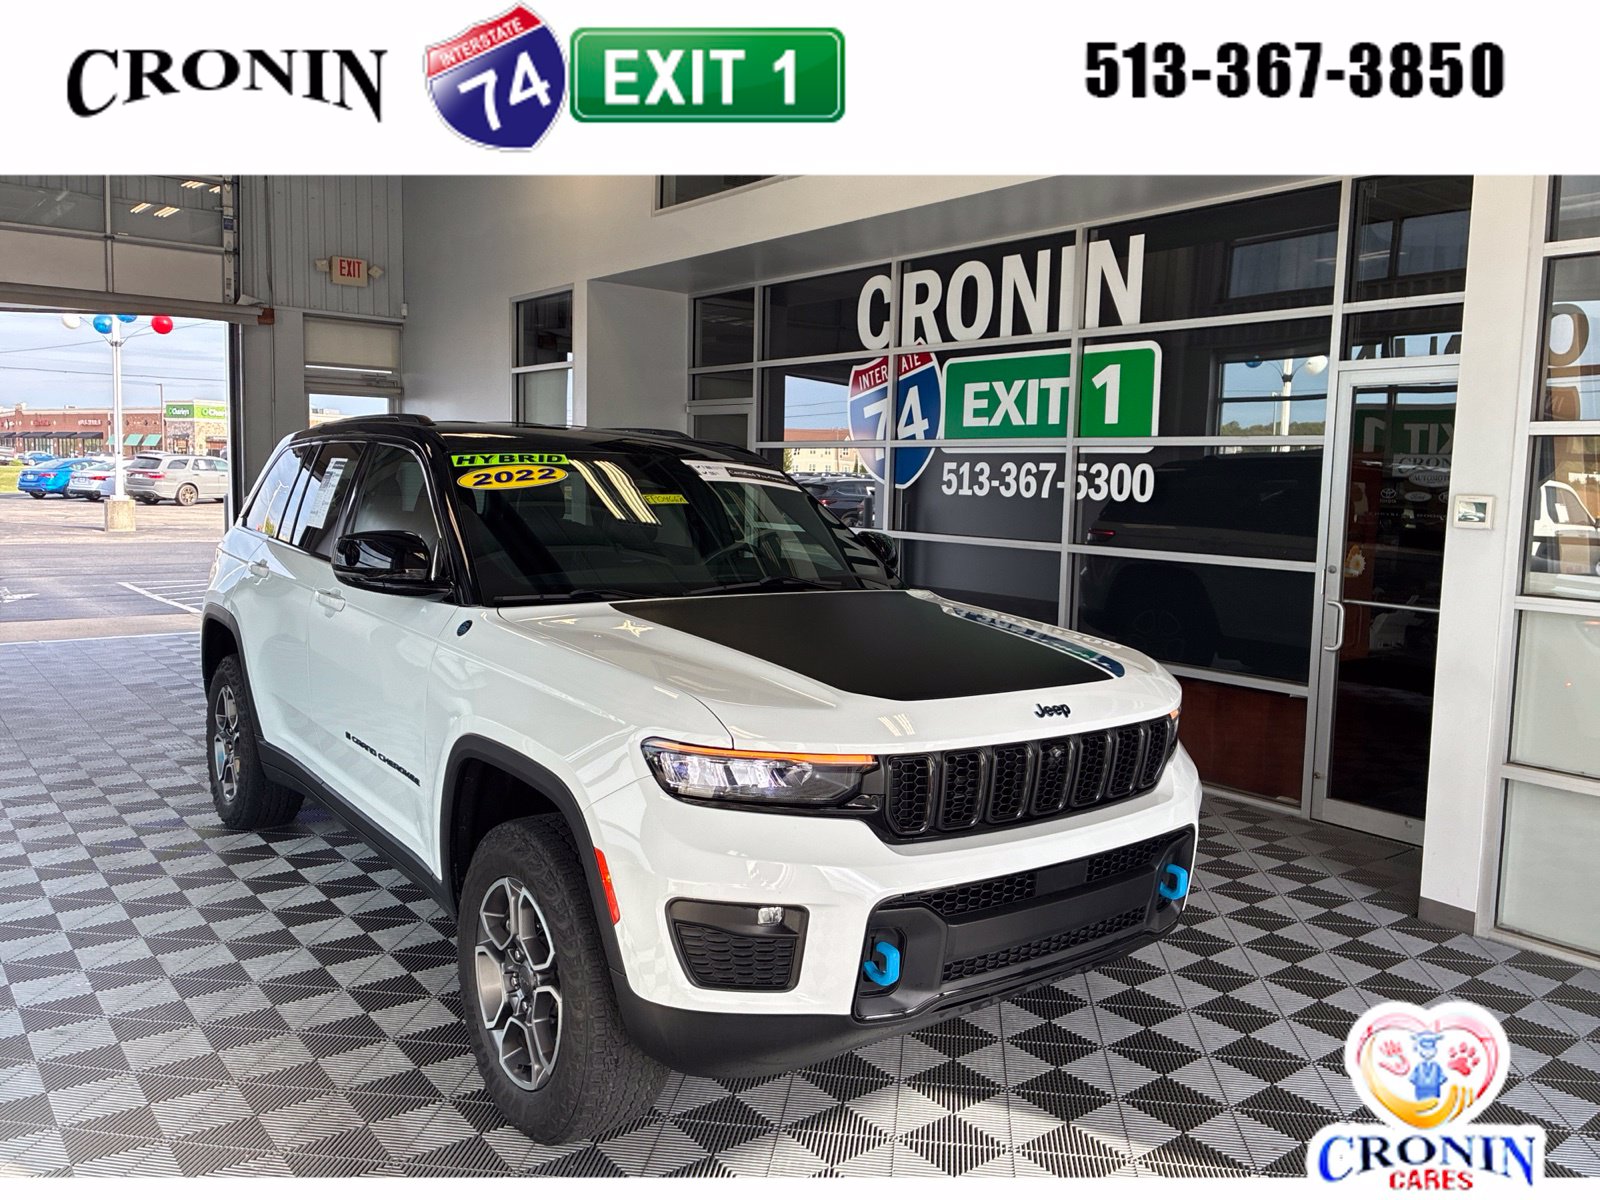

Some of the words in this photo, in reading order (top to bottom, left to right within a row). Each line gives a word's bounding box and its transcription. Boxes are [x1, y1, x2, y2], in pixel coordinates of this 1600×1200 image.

[338, 258, 363, 279] EXIT
[857, 233, 1146, 351] CRONIN
[858, 353, 922, 392] INTERATE
[962, 376, 1070, 428] EXIT
[1092, 363, 1121, 425] 1
[863, 384, 930, 461] 74
[456, 454, 562, 465] HYBRID
[1398, 457, 1452, 474] CRON
[473, 468, 558, 487] 2022
[941, 462, 1155, 503] 513-367-5300
[1034, 703, 1071, 718] Jeep
[378, 753, 420, 787] CHEROKEE
